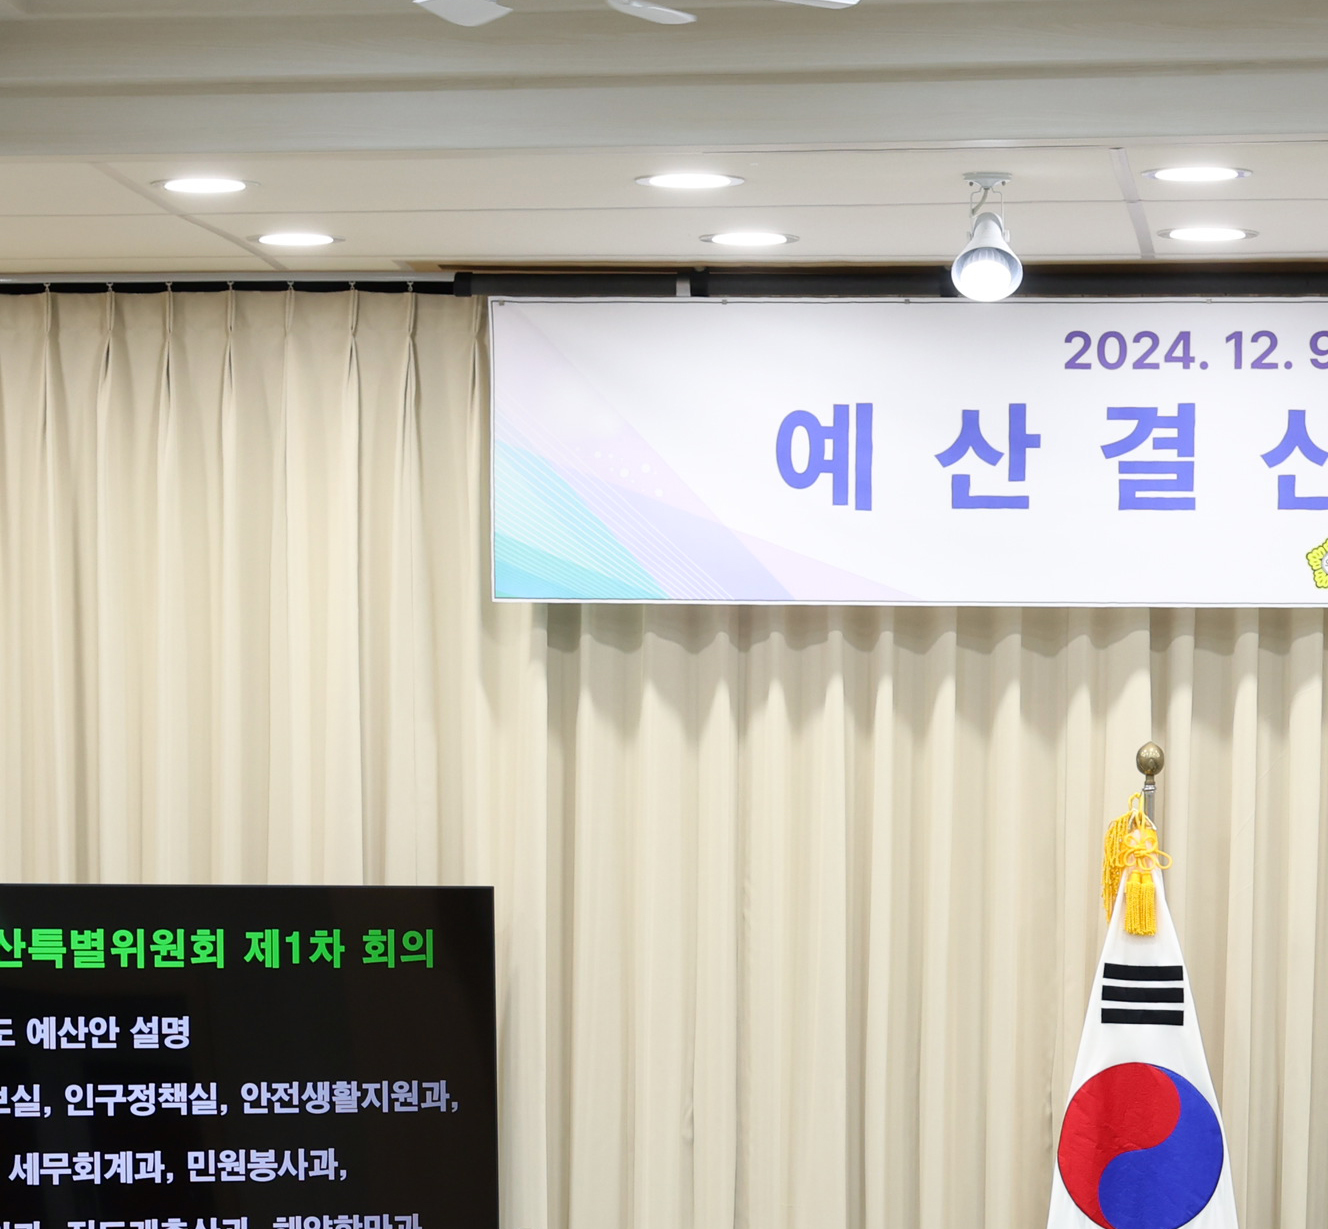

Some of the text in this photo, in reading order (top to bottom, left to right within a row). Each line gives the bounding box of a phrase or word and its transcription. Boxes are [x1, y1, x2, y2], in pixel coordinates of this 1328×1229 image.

[1063, 329, 1209, 371] 2024.
[1225, 329, 1293, 370] 12.
[243, 928, 346, 969] 제1차
[362, 929, 434, 969] 회의
[26, 1015, 120, 1050] 예산안
[129, 1015, 190, 1050] 설명
[64, 1082, 228, 1117] 인구정책실,
[240, 1080, 460, 1115] 안전생활지원과,
[8, 1150, 174, 1186] 세무회계과,
[187, 1147, 347, 1183] 민원봉사과,
